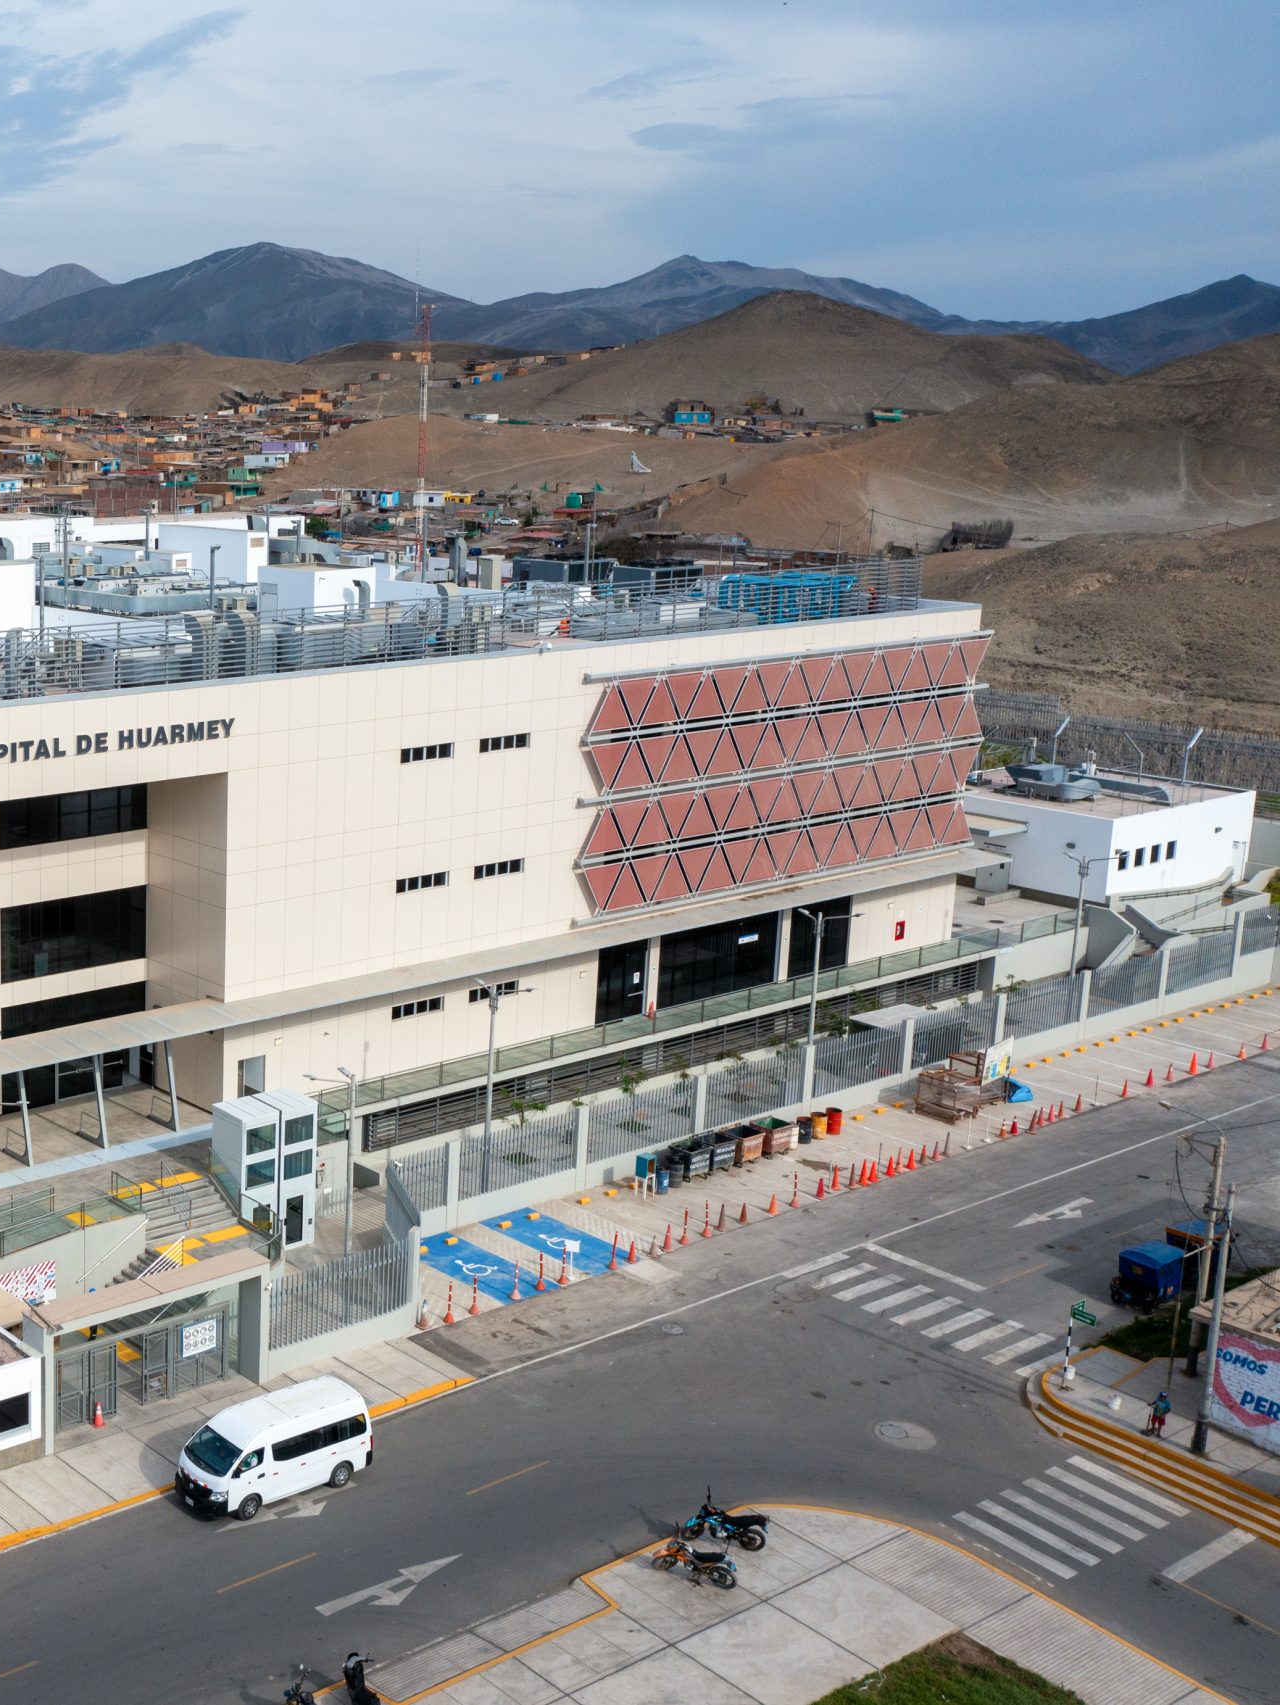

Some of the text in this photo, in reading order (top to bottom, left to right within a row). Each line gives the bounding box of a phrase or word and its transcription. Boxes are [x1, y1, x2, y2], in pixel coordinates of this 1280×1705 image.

[76, 732, 109, 755] DE
[118, 718, 236, 751] HUARMEY
[1216, 1347, 1268, 1375] SOMOS
